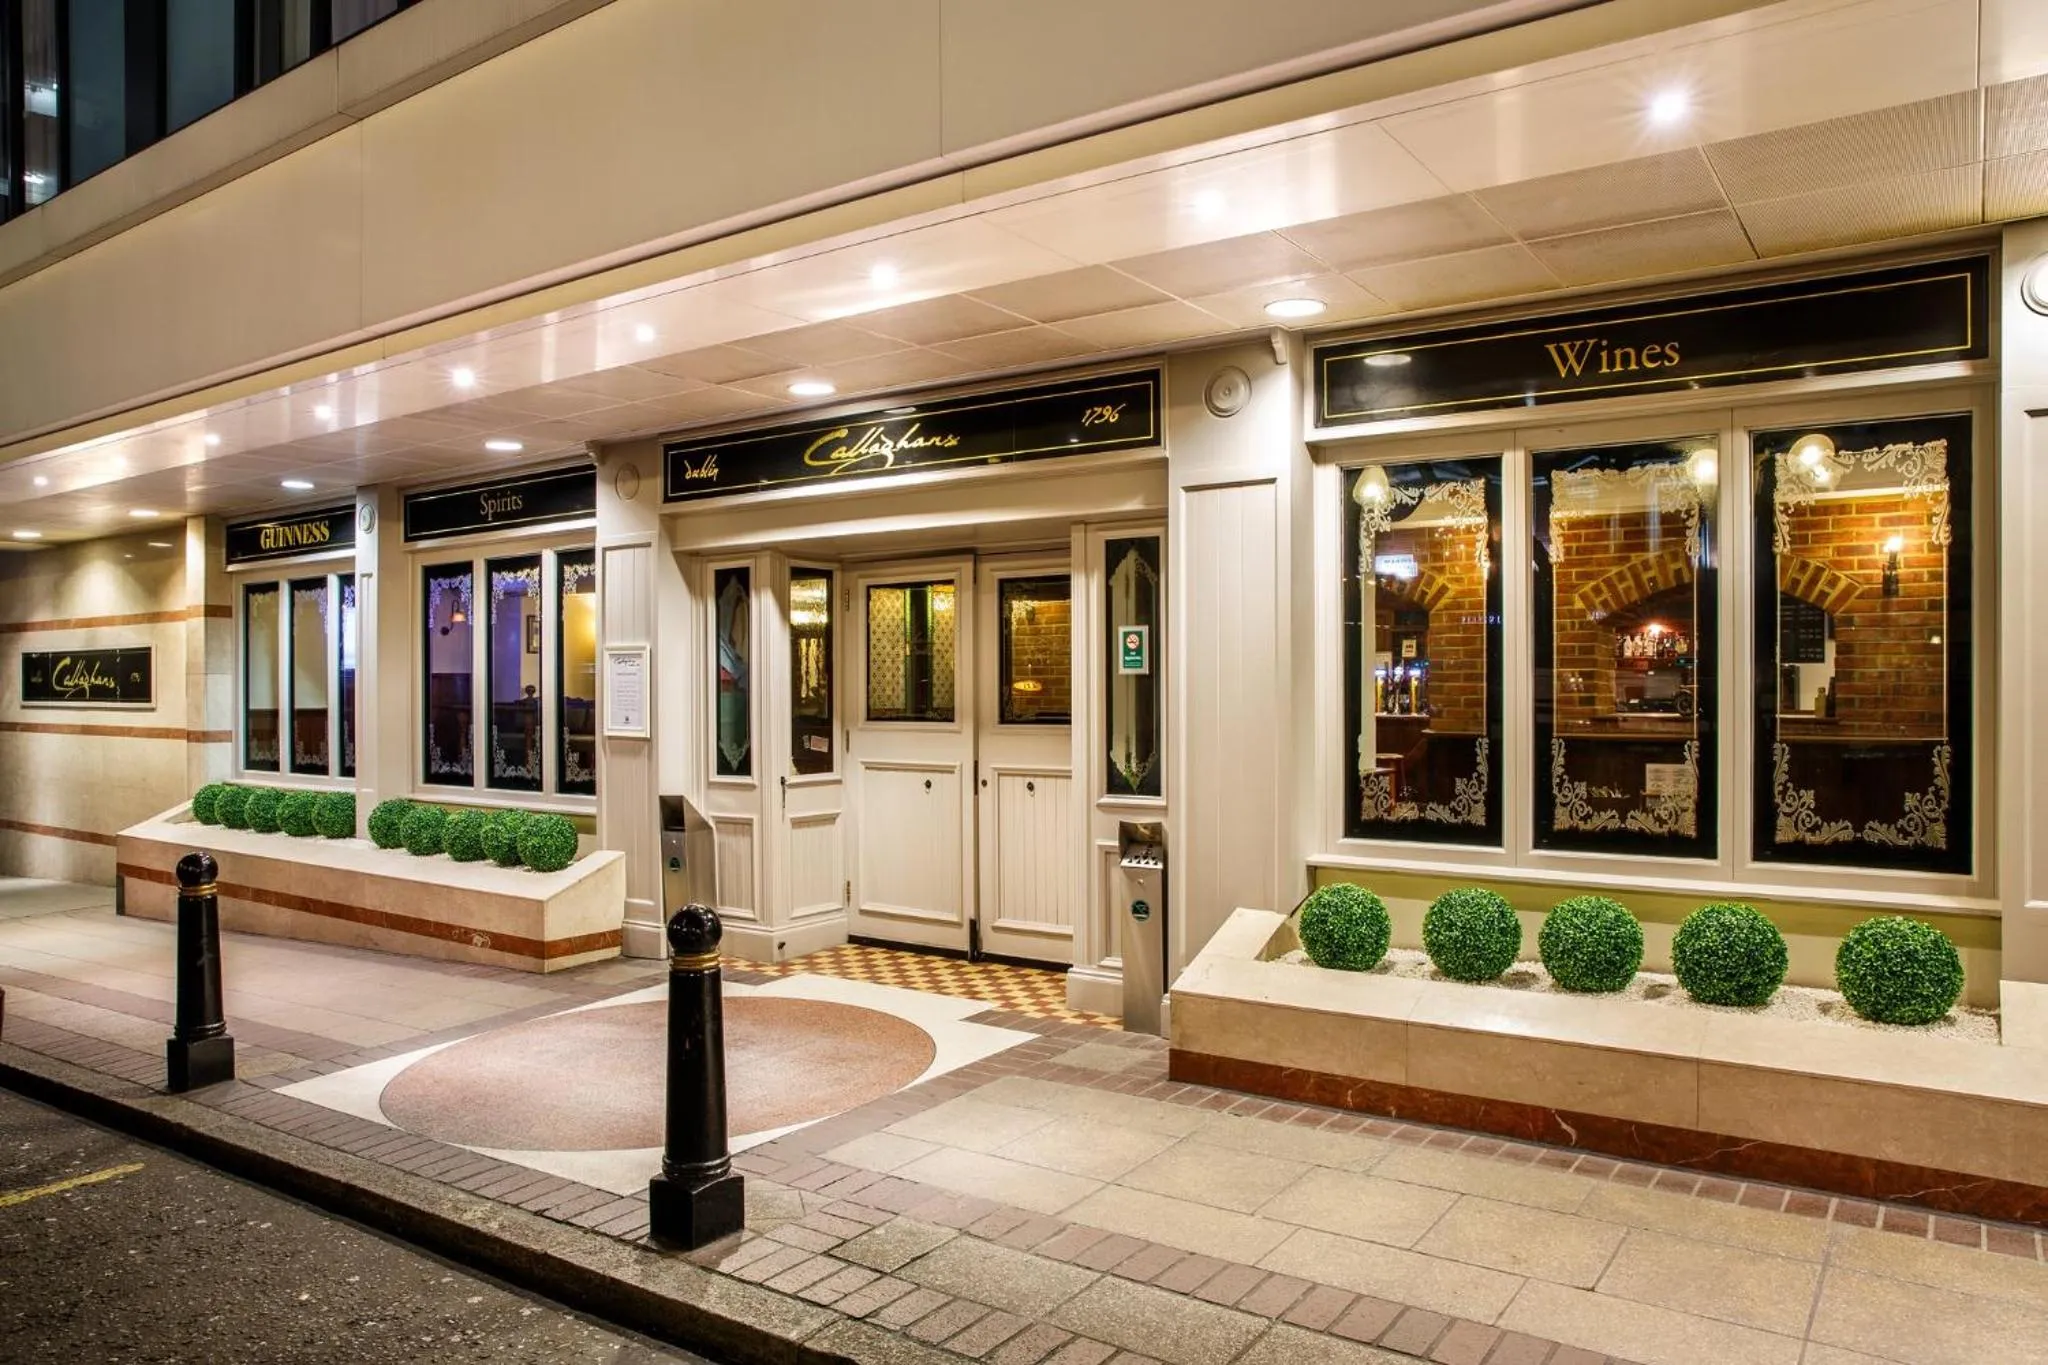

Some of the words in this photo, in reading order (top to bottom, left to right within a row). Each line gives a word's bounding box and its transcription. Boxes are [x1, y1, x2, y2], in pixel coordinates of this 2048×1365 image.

[1544, 338, 1680, 378] Wines
[803, 423, 960, 475] Callaghans
[1081, 403, 1126, 426] 1796
[480, 490, 523, 520] Spirits
[260, 520, 330, 550] GUINNESS
